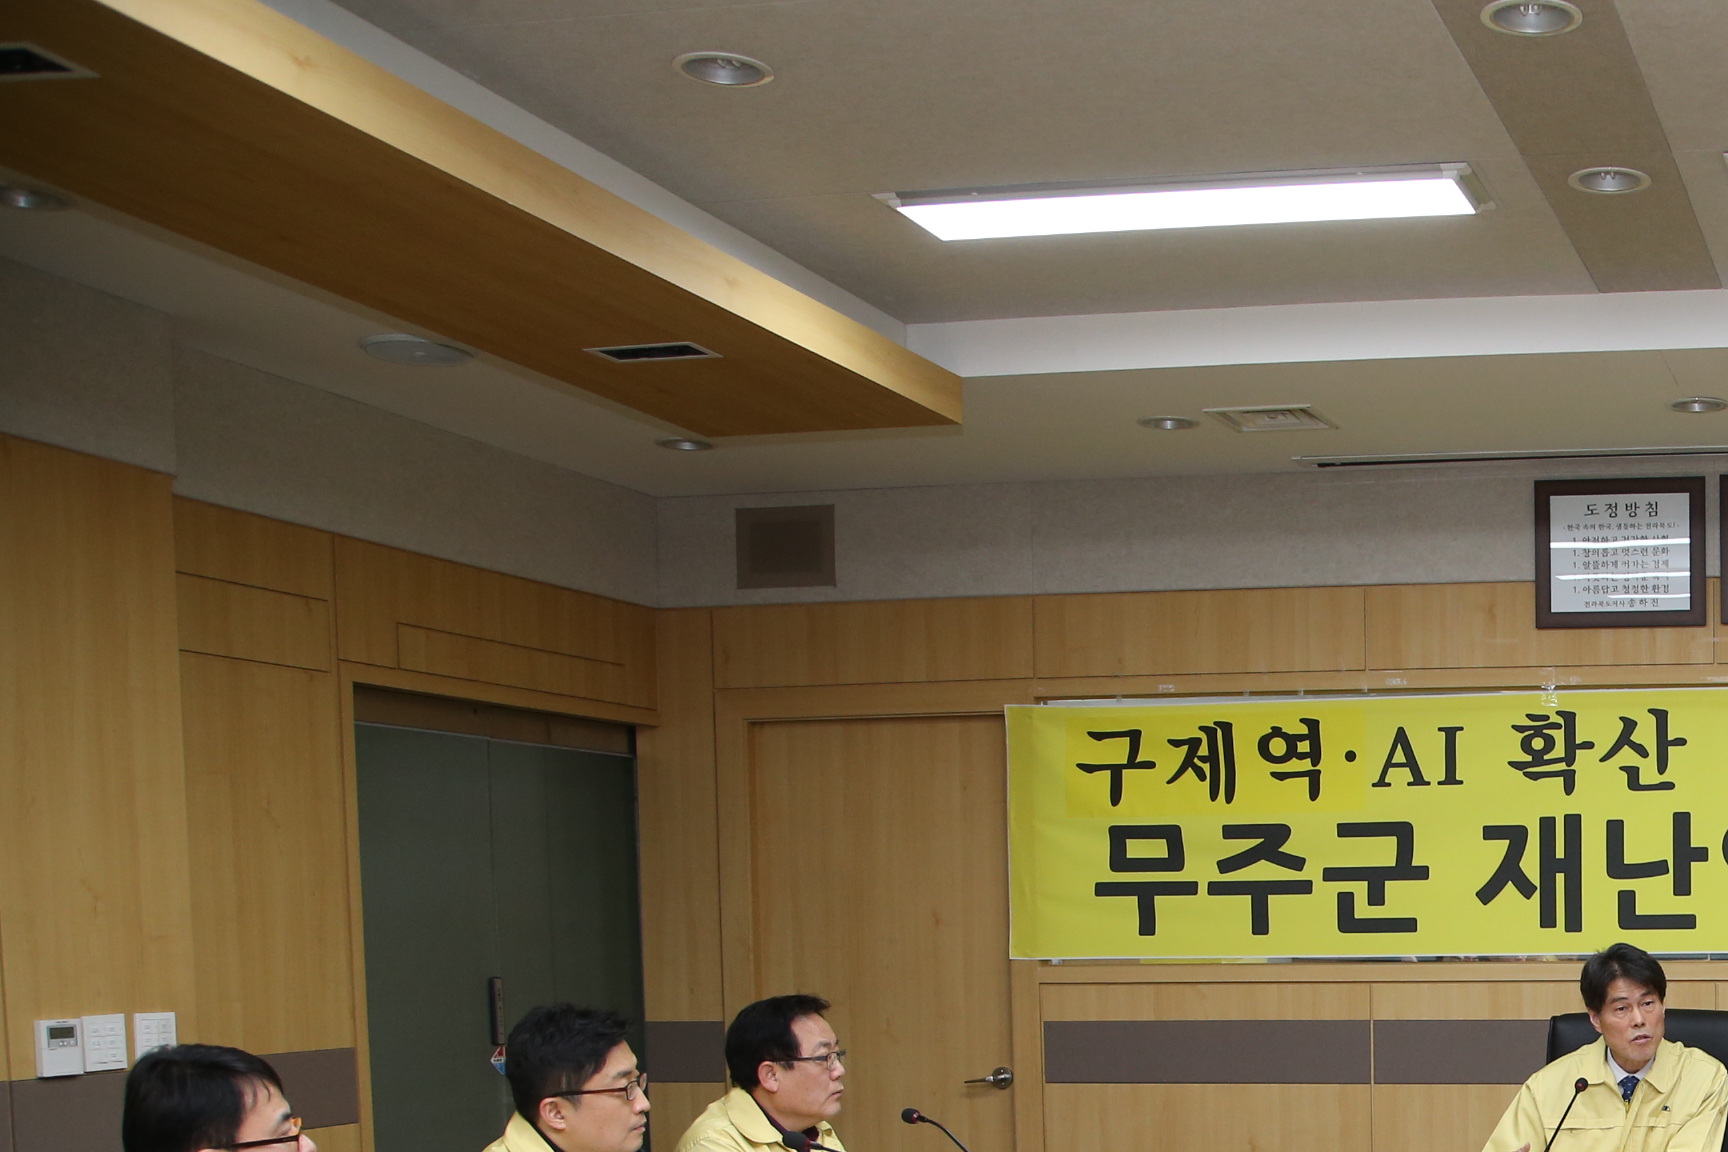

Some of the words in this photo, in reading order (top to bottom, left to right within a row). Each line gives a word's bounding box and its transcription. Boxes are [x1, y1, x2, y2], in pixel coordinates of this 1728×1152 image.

[1584, 501, 1659, 518] 도정방침
[1582, 585, 1619, 595] 아름답고
[1508, 708, 1687, 796] 확산
[1095, 822, 1429, 936] 무주군
